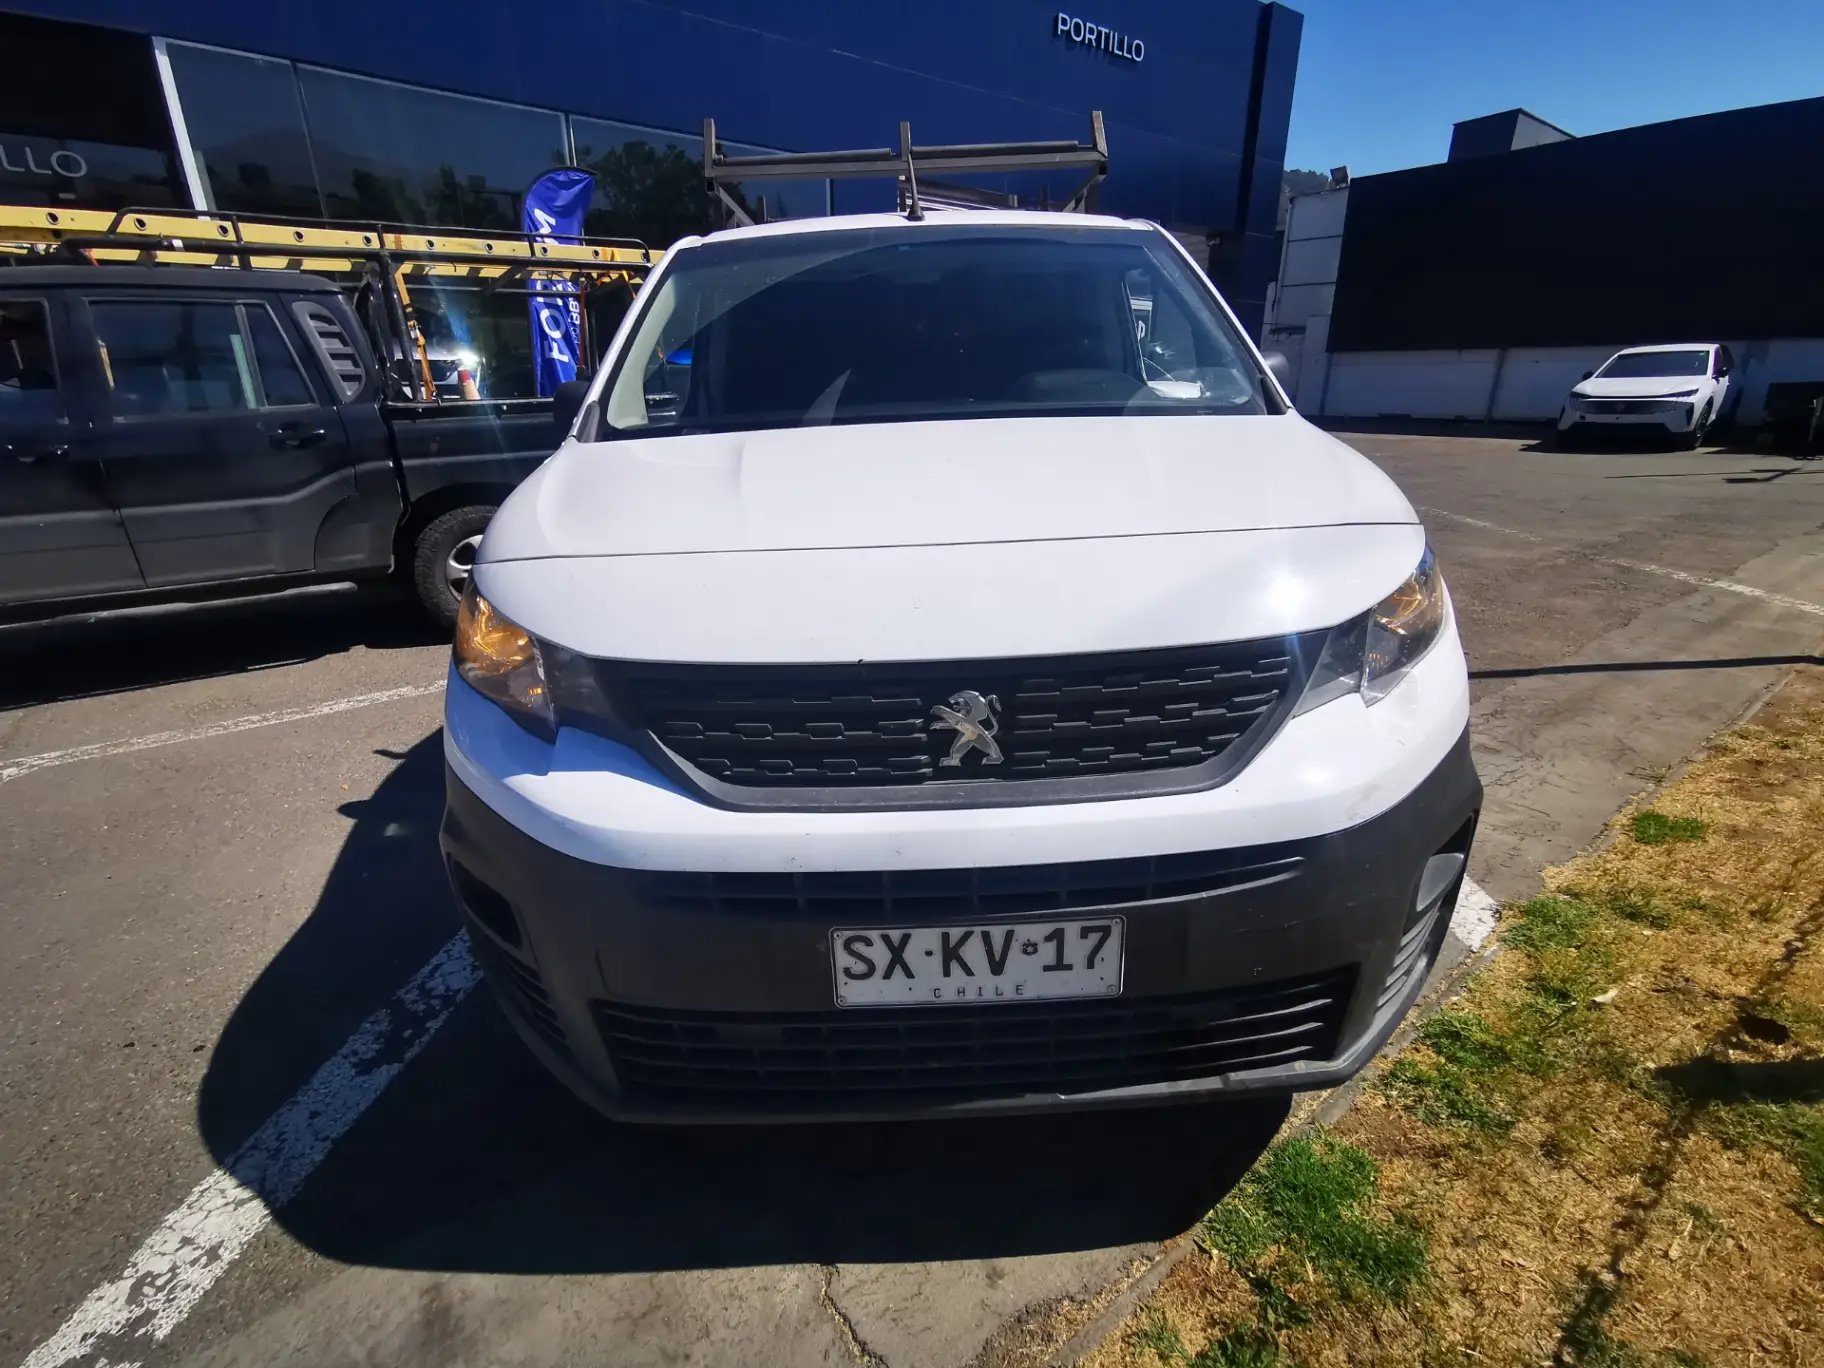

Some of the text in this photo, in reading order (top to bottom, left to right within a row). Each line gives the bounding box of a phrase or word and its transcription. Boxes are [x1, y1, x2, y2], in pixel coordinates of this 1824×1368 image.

[1058, 12, 1145, 62] PORTILLO
[534, 208, 570, 363] FORM
[933, 983, 1025, 999] CHILE
